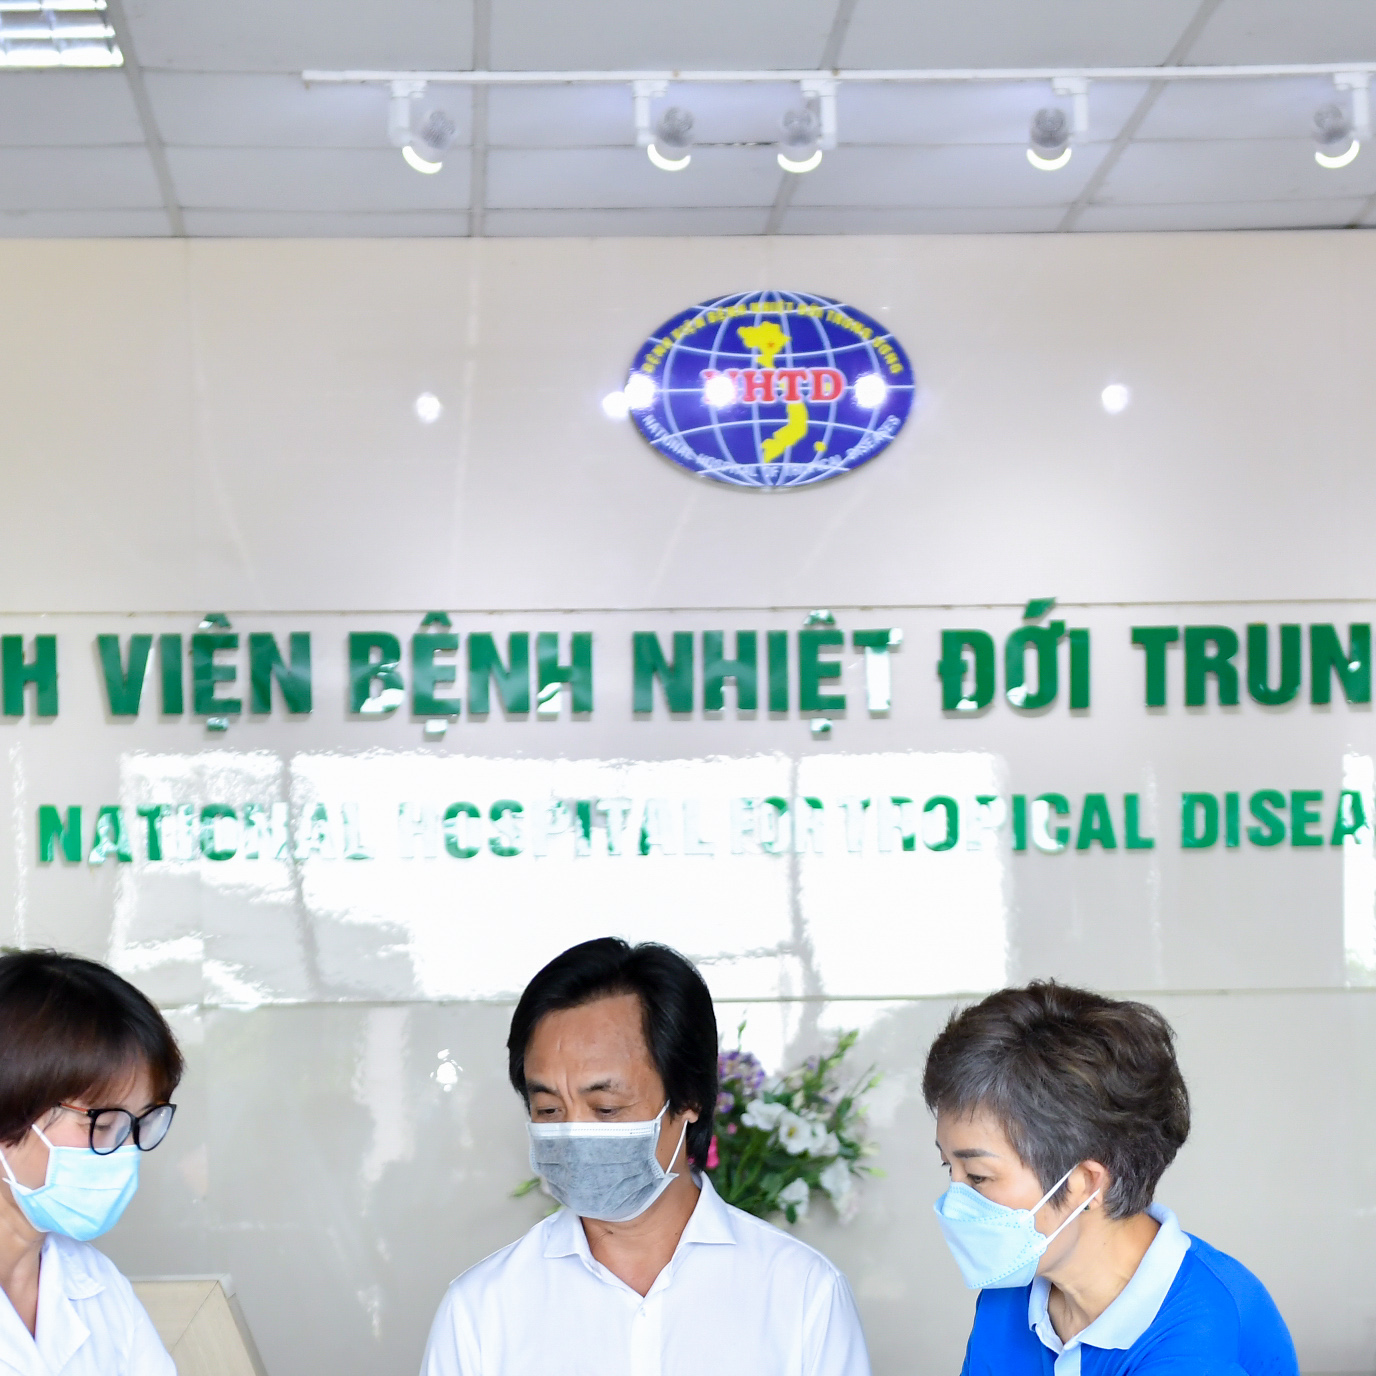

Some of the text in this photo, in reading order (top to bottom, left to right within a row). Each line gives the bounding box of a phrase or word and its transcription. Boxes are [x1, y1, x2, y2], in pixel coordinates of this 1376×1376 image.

[98, 612, 314, 731] VIỆN
[348, 610, 594, 733] BỆNH
[631, 609, 903, 737] NHIỆT
[938, 598, 1091, 712] ĐỚI
